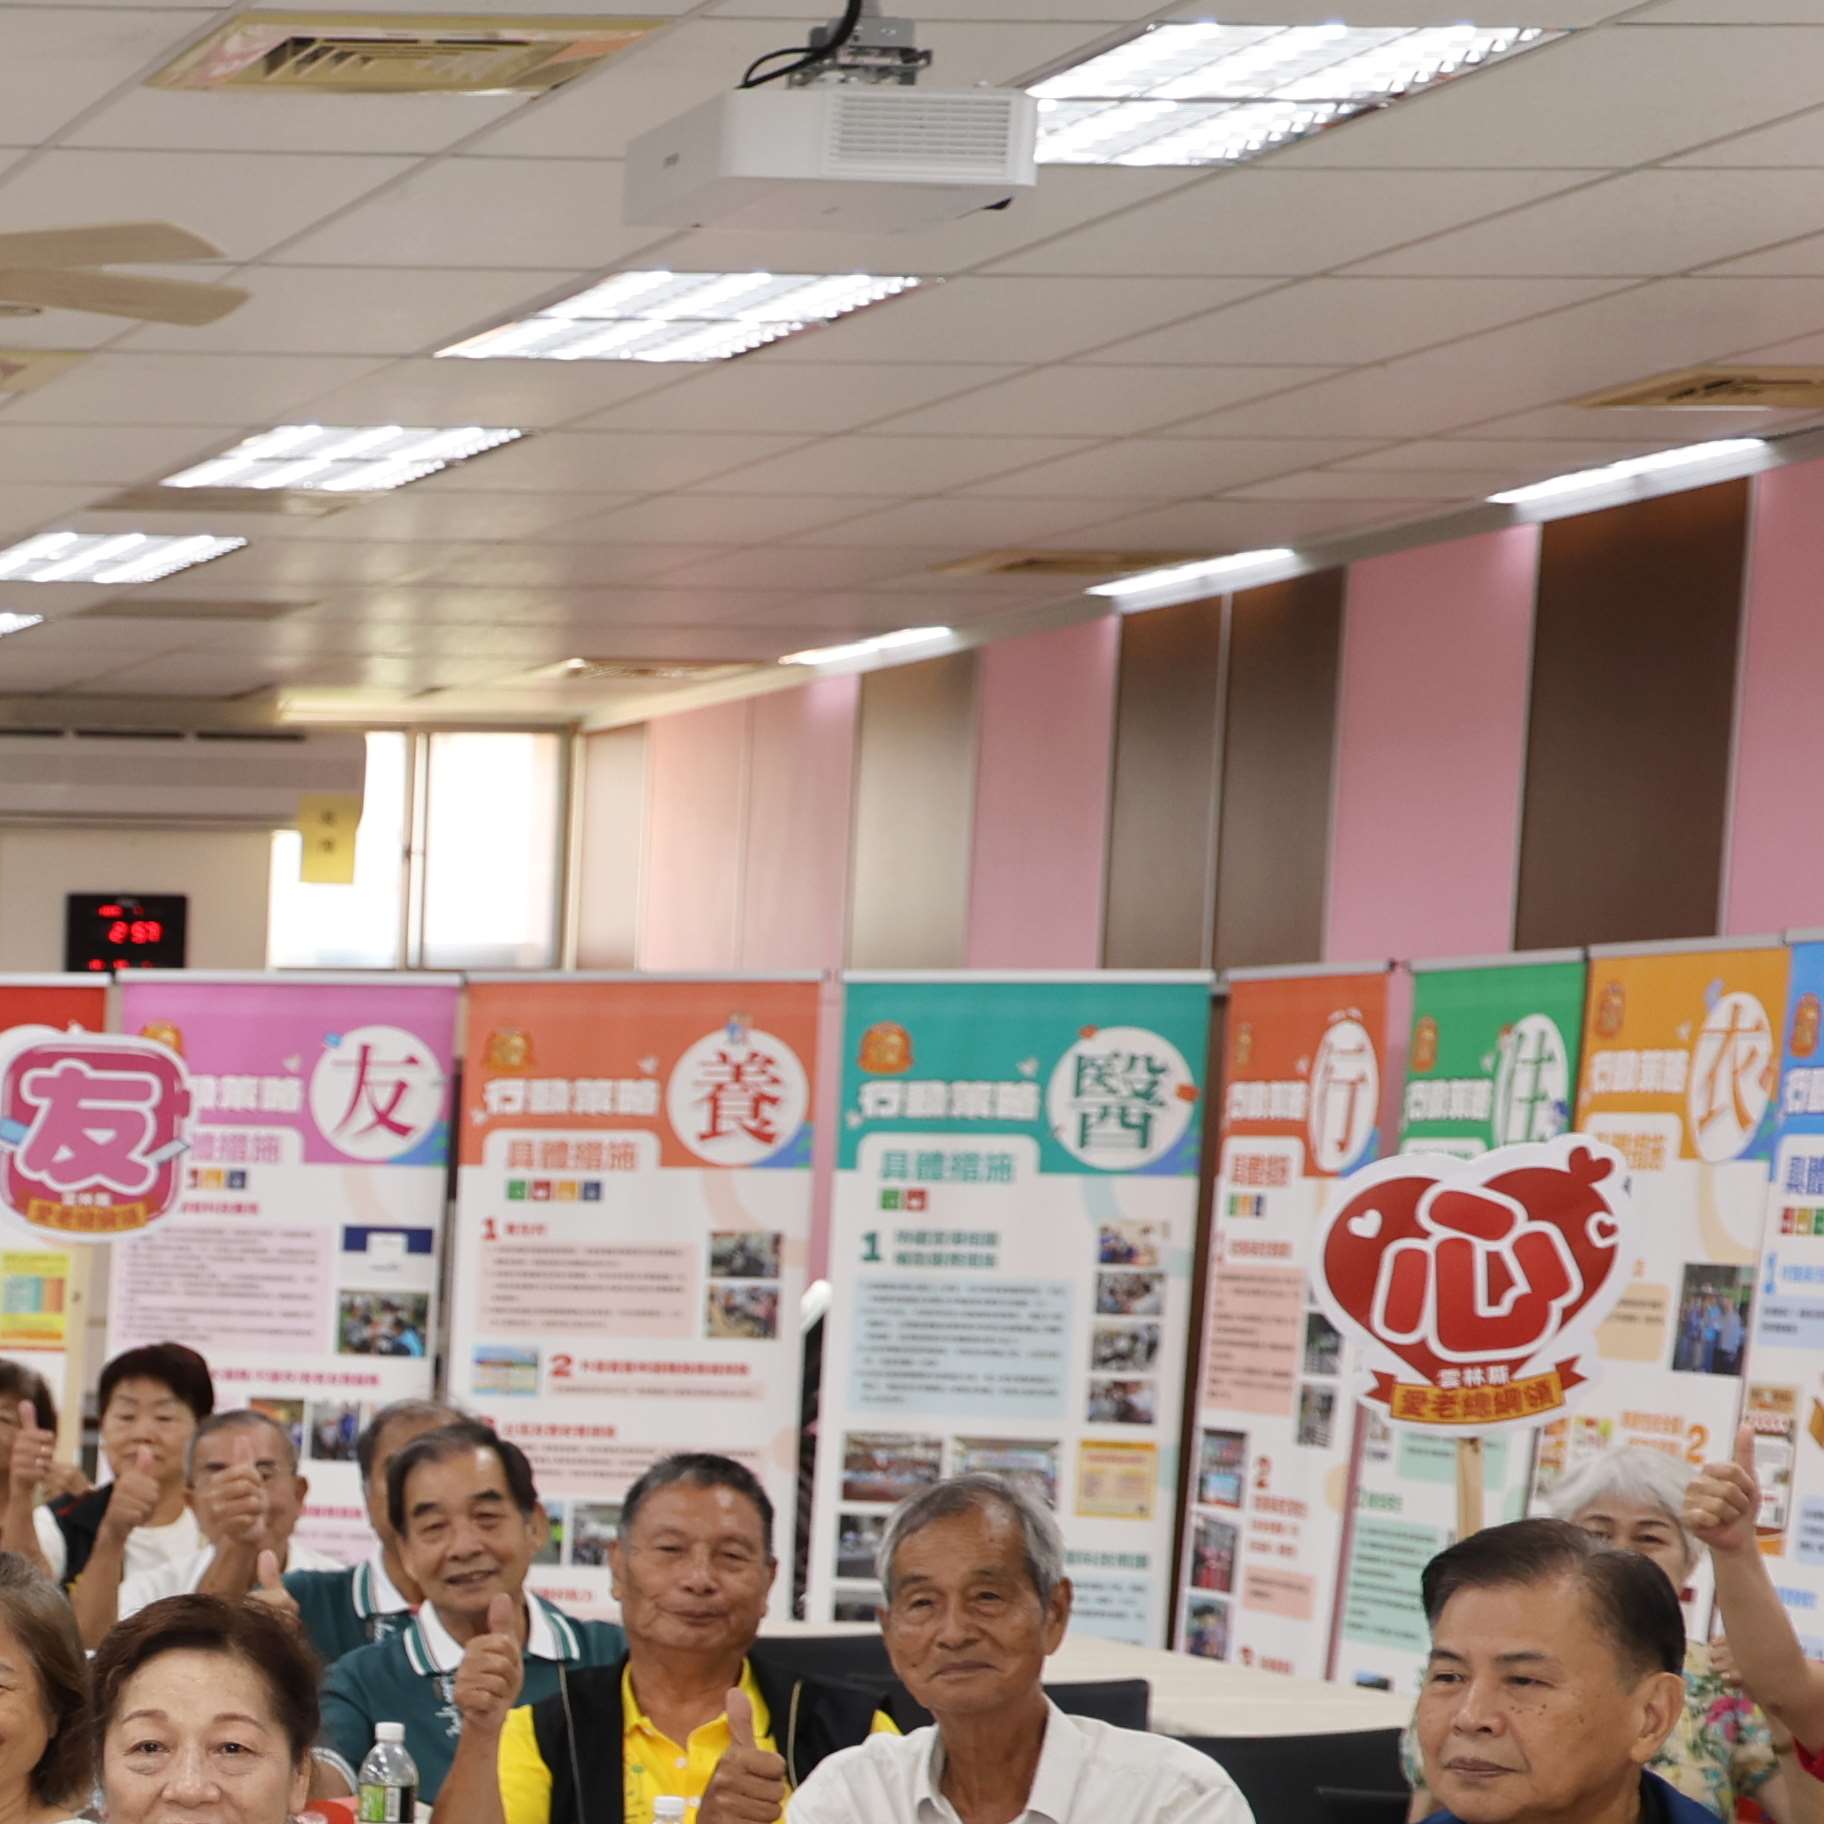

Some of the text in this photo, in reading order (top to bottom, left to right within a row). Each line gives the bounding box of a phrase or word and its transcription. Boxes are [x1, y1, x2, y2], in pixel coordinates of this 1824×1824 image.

[25, 1063, 154, 1188] 友
[331, 1044, 421, 1142] 友
[693, 1049, 782, 1145] 養
[1074, 1051, 1167, 1150] 醫
[483, 1218, 497, 1240] 1
[862, 1232, 880, 1261] 1
[1373, 1190, 1581, 1360] 心
[551, 1354, 572, 1377] 2
